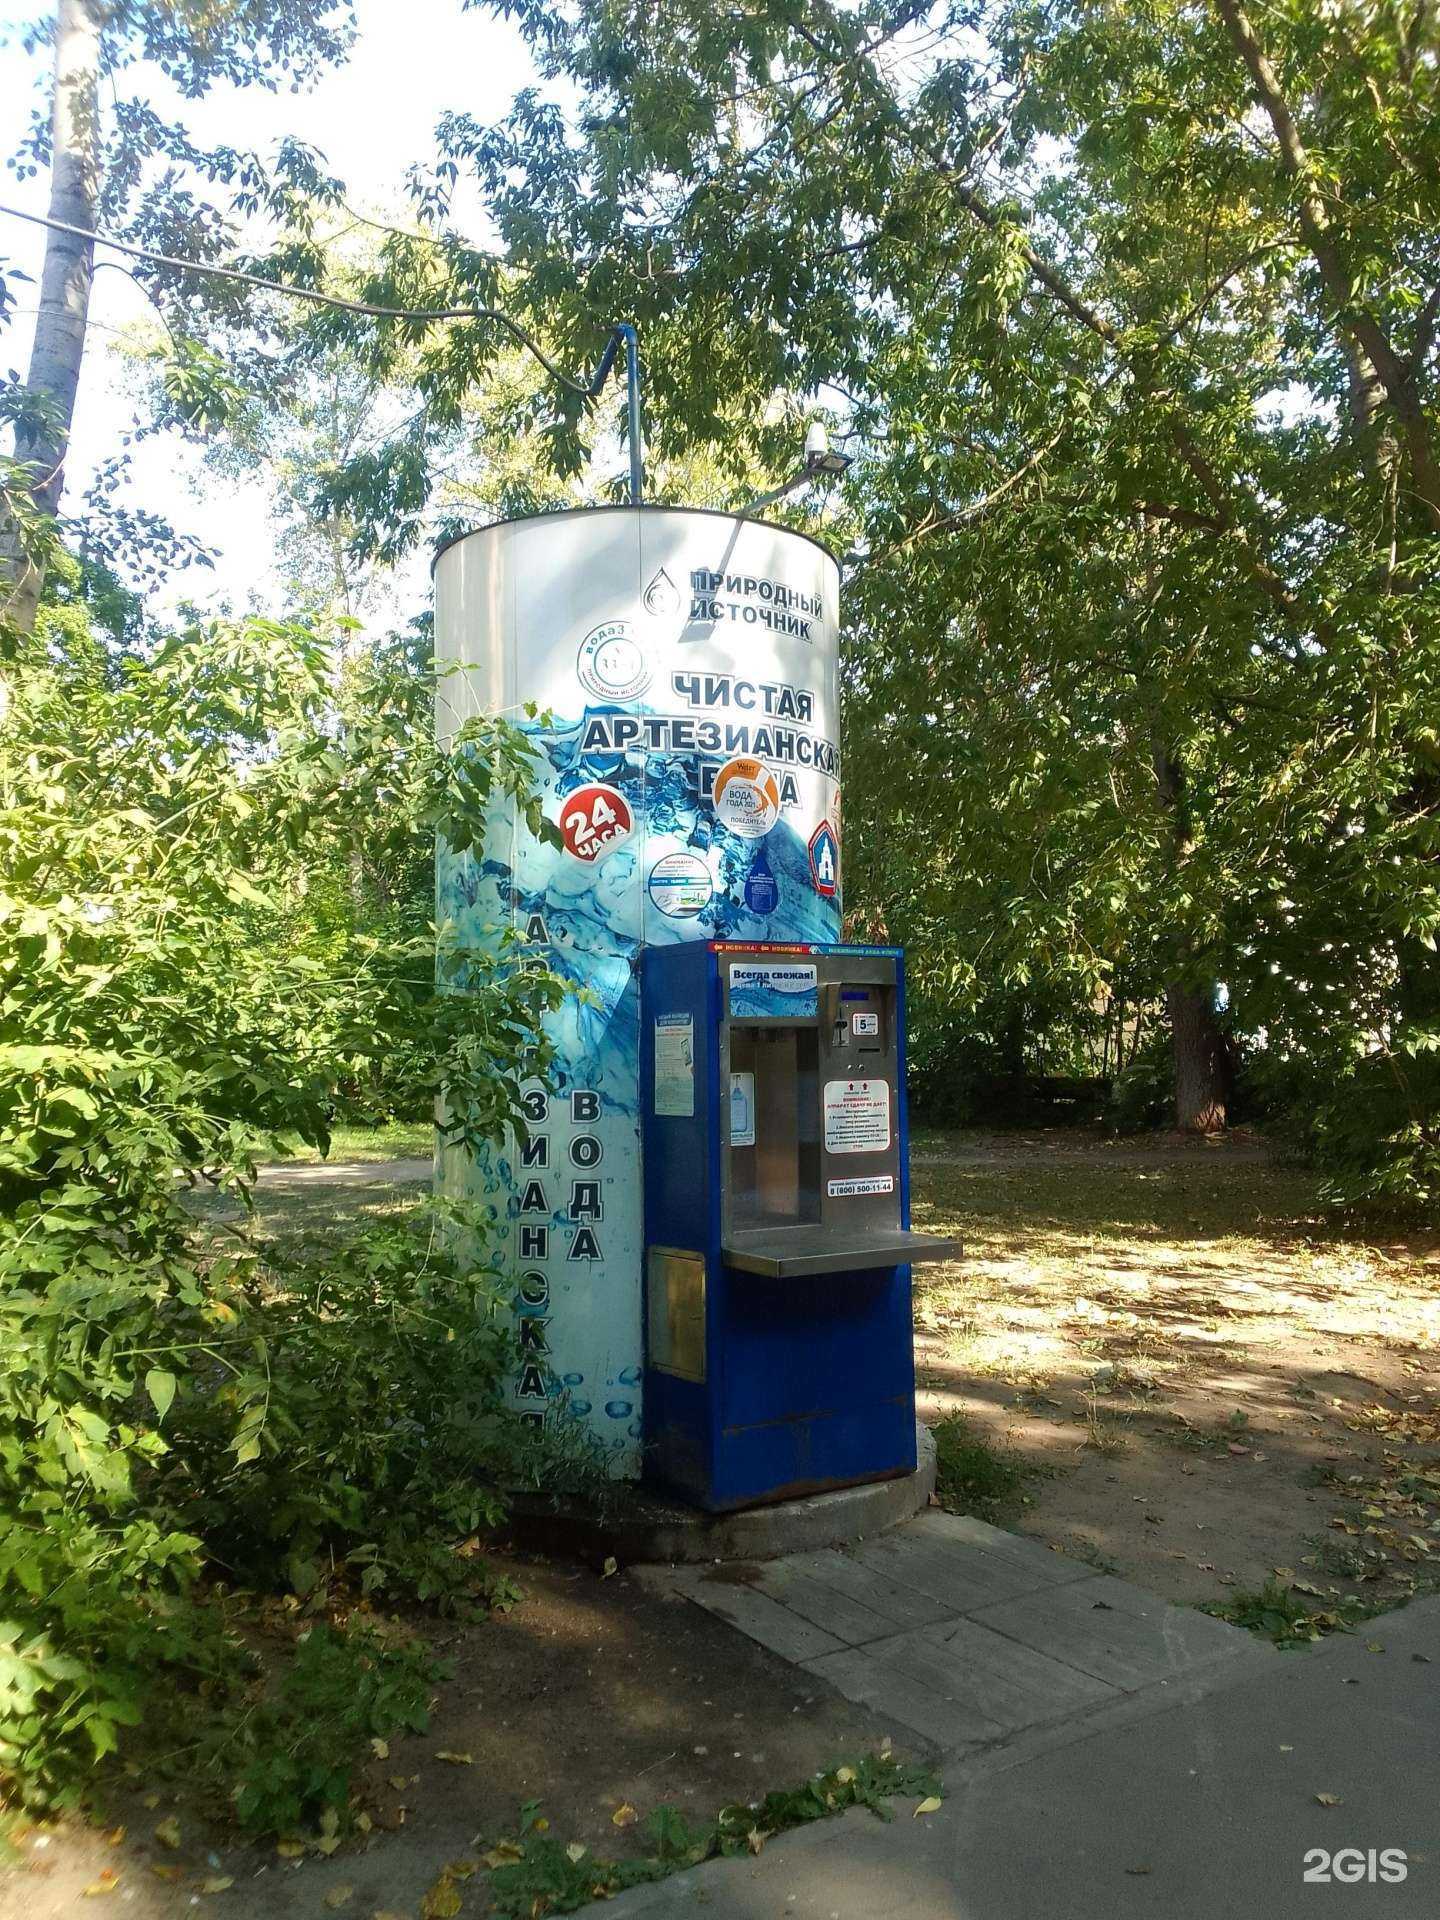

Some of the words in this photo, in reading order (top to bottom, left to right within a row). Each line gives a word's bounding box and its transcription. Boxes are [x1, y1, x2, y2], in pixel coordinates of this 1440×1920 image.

[692, 572, 823, 619] ПРИРОДНЫЙ
[690, 599, 810, 640] ИСТОЧНИК
[674, 675, 812, 722] ЧИСТАЯ
[565, 795, 616, 845] 24
[578, 824, 628, 855] ЧАСА
[733, 970, 770, 981] Всегда
[771, 970, 814, 980] свежая!
[860, 1019, 867, 1030] 5
[569, 1090, 602, 1261] ВОДА
[857, 1183, 891, 1192] 500-11-44
